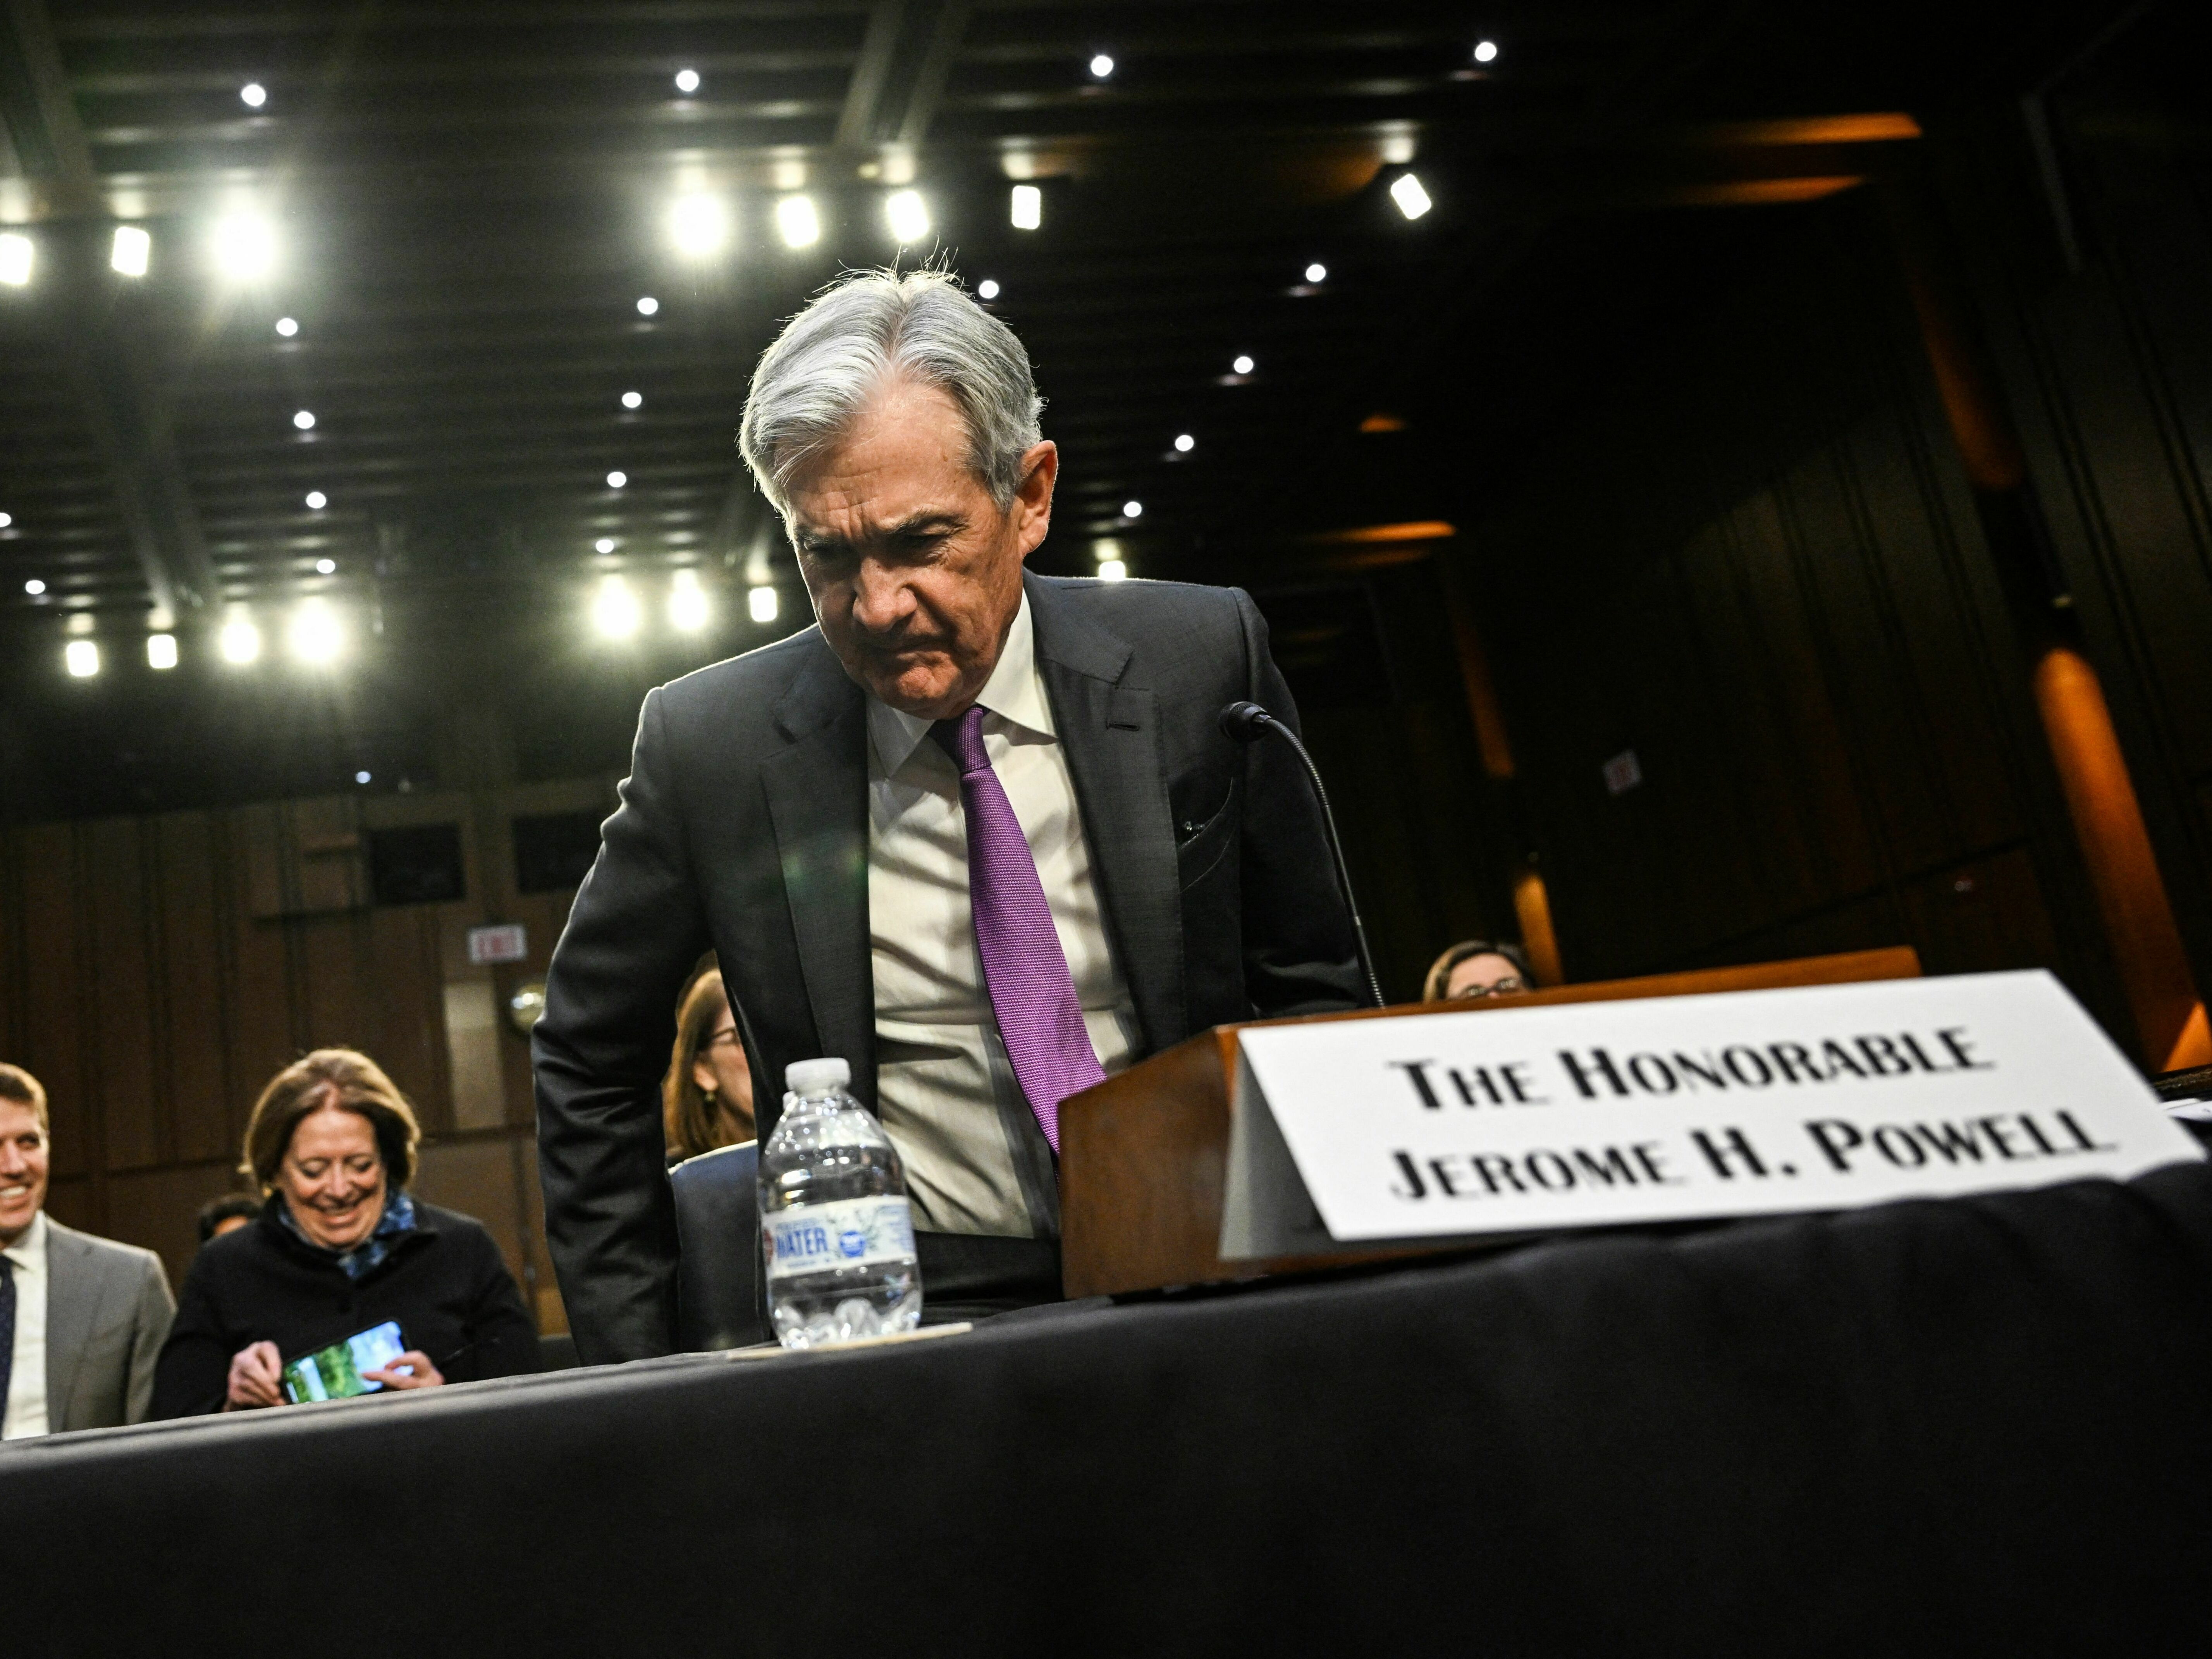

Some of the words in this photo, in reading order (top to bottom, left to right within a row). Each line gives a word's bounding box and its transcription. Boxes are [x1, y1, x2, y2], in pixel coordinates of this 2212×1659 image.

[1387, 1058, 1550, 1110] THE
[1557, 1028, 1995, 1100] HONORABLE
[1391, 1140, 1685, 1200] JEROME
[1689, 1126, 1798, 1180] H.
[1803, 1109, 2120, 1173] POWELL
